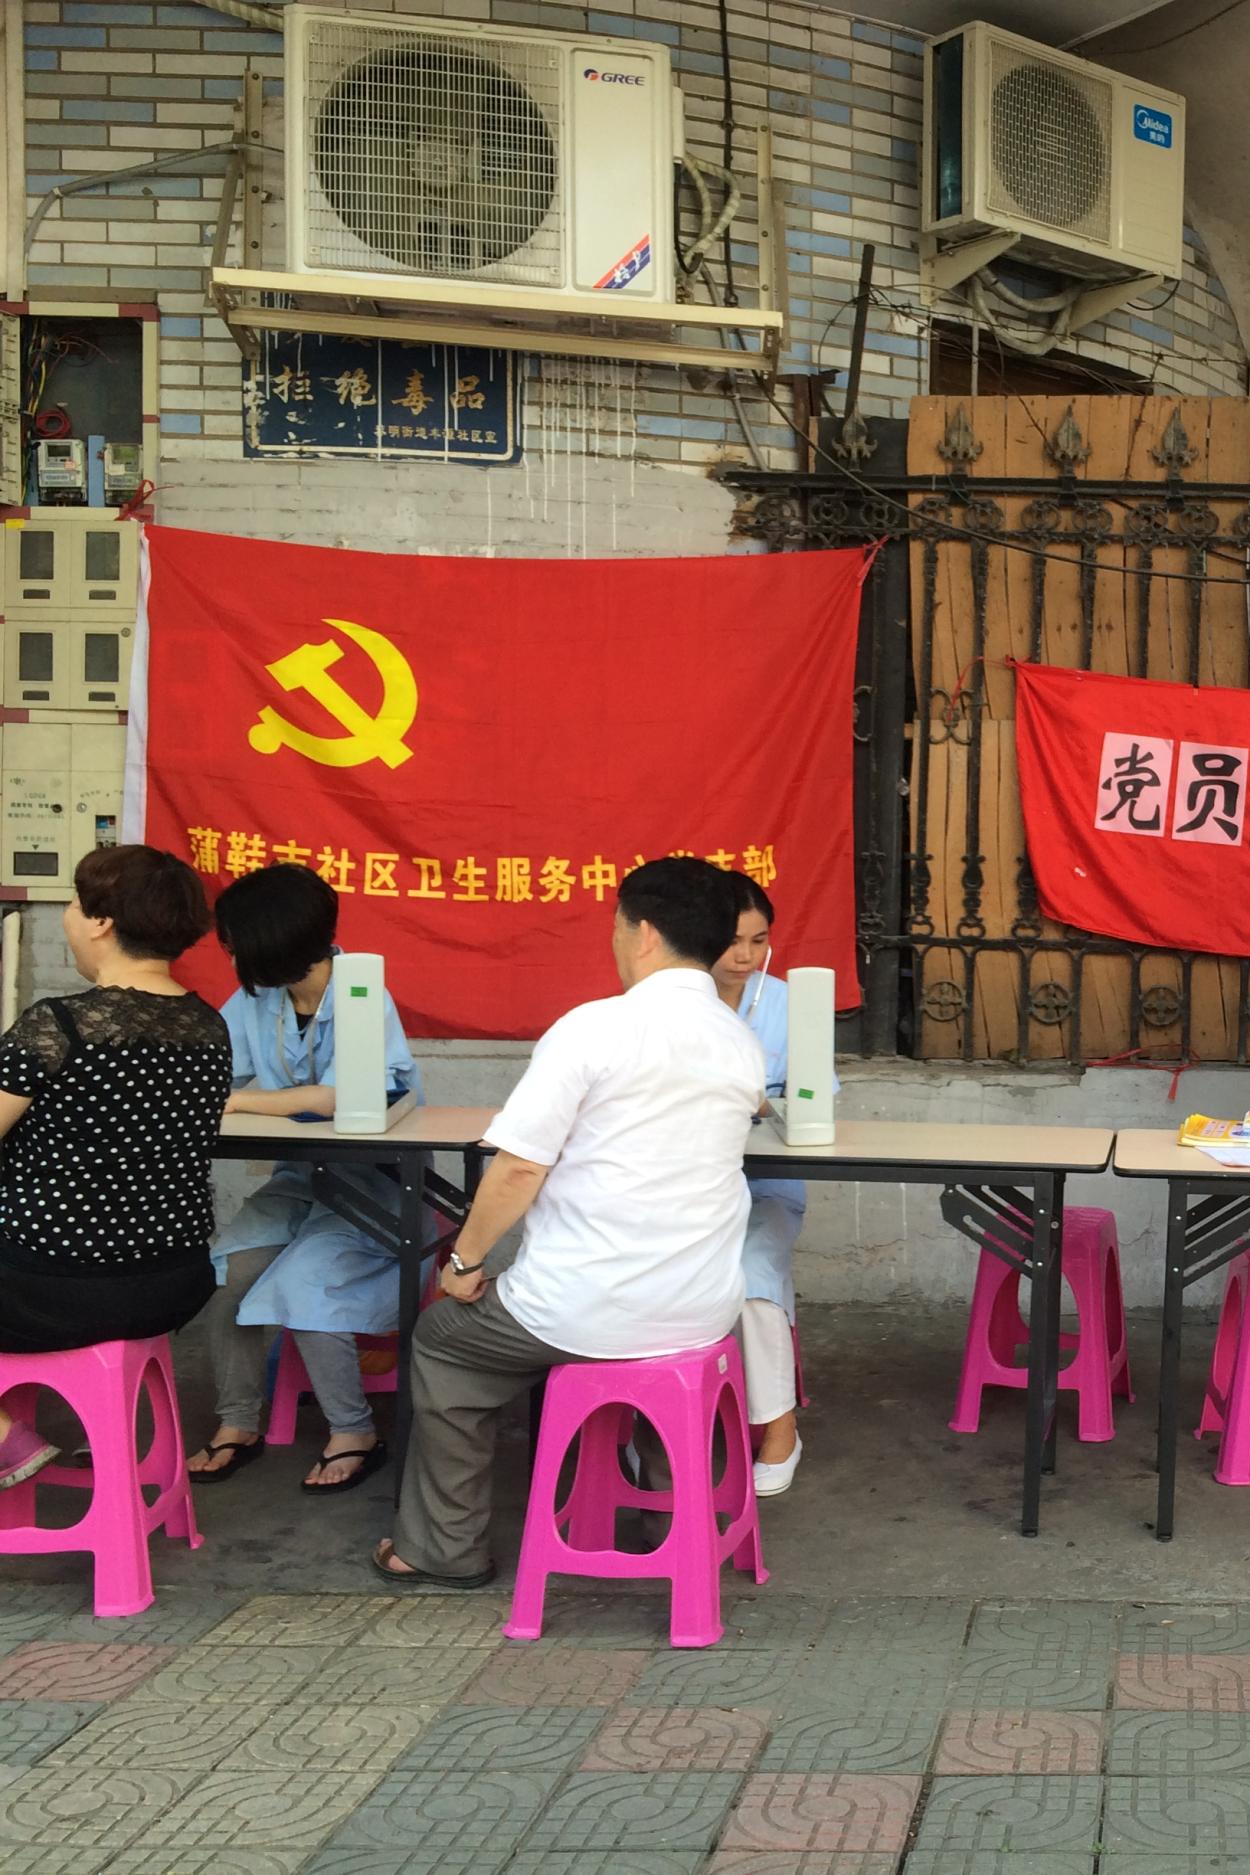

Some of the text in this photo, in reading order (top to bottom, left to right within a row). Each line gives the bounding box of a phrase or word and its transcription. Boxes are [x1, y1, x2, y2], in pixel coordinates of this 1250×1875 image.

[601, 72, 646, 86] GREE
[1140, 114, 1169, 134] Midea
[272, 364, 487, 416] 拒绝毒品
[186, 826, 778, 903] 蒲鞋社区卫生服务中部
